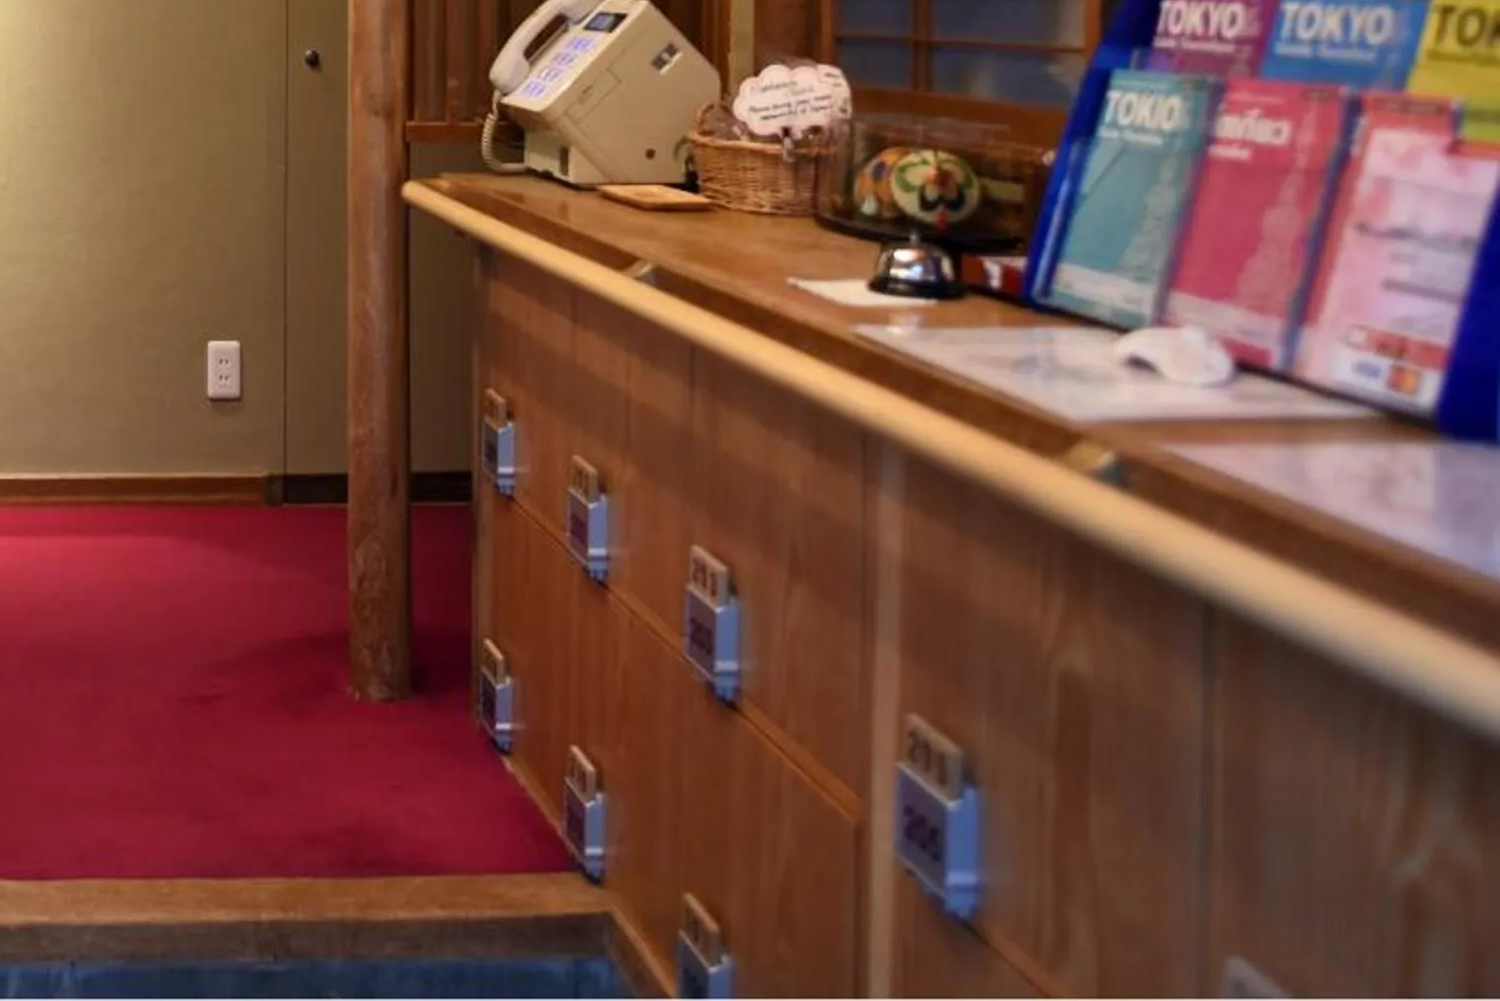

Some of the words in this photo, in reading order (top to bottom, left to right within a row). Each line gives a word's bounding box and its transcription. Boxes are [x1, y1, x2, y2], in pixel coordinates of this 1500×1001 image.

[1156, 0, 1246, 39] TOKYO
[1280, 1, 1395, 46] TOKYO
[1103, 89, 1184, 130] TOKIO
